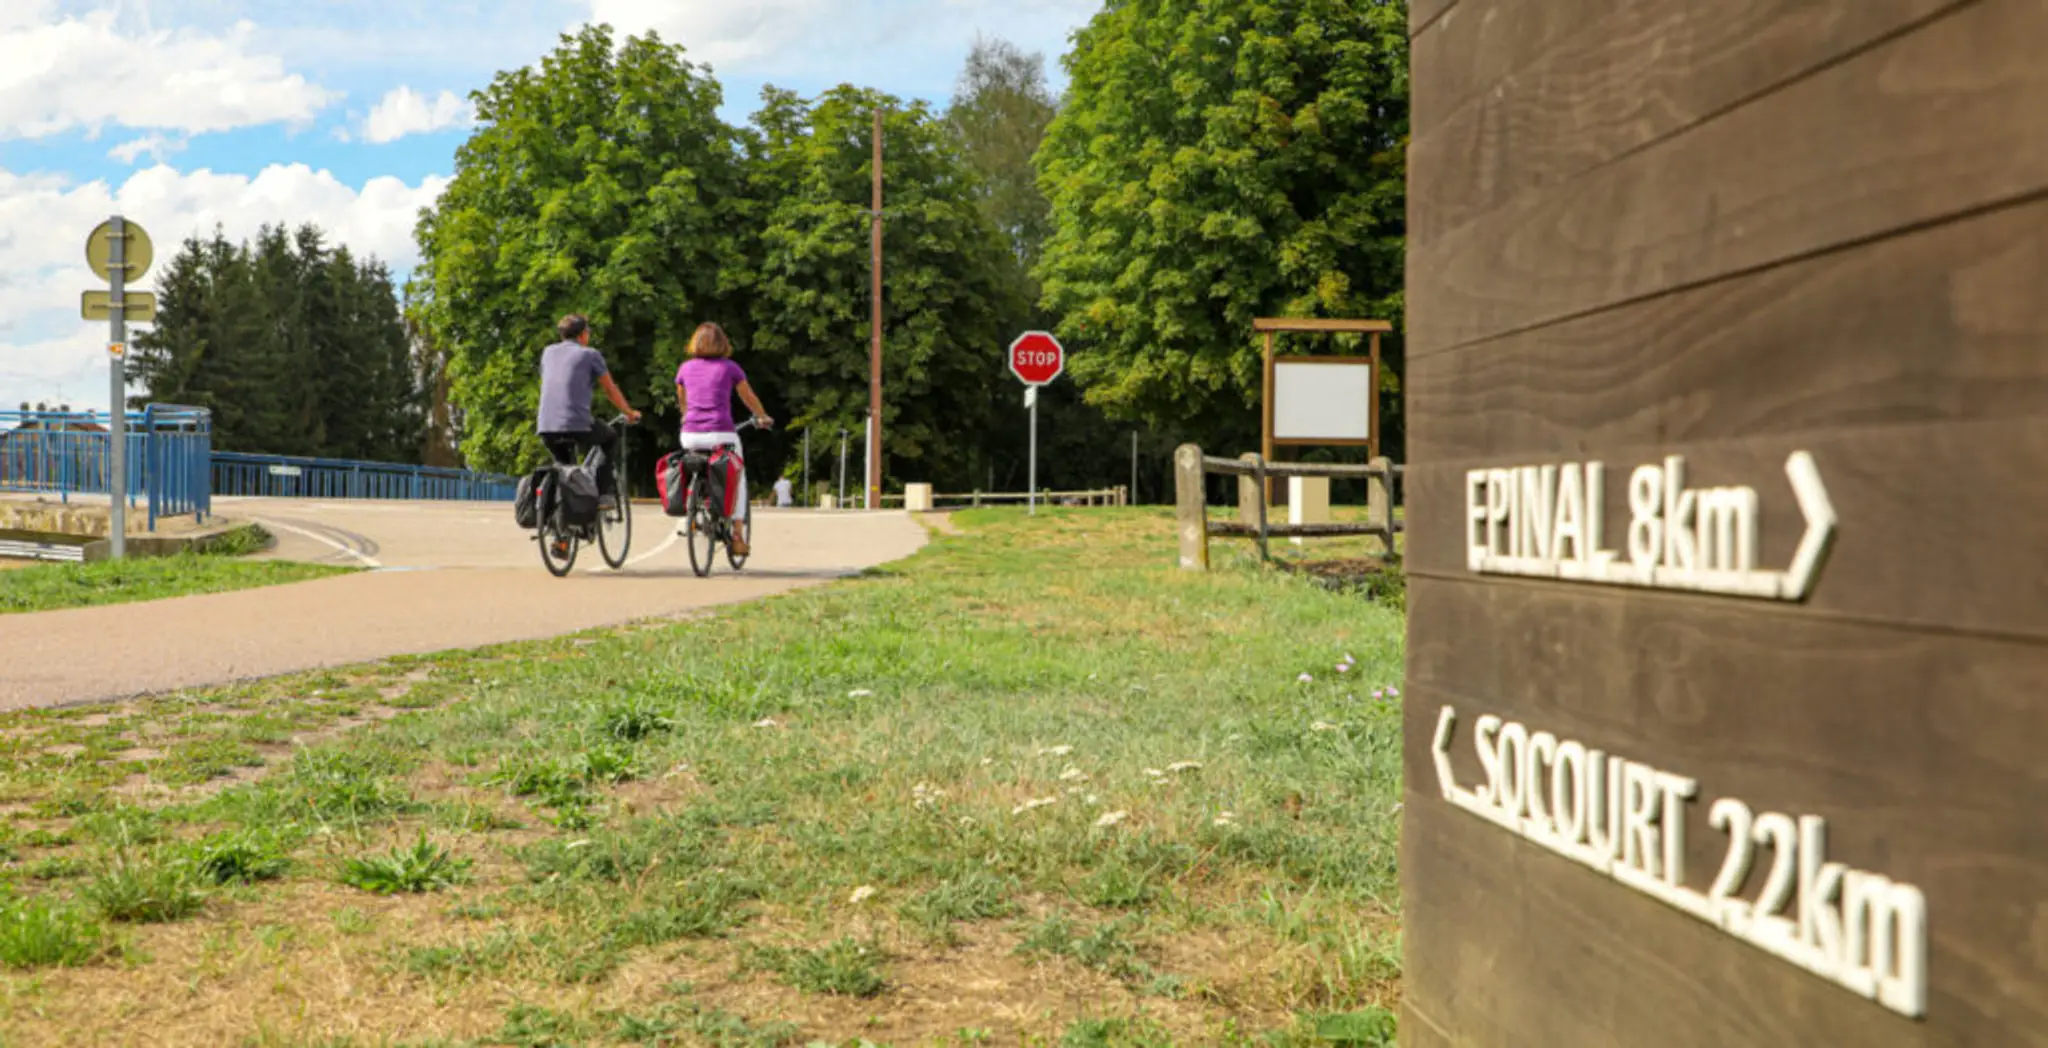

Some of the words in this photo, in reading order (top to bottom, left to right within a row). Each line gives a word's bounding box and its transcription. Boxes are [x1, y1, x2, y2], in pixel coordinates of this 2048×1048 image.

[1017, 350, 1057, 366] STOP
[1467, 461, 1618, 570] EPINAL
[1628, 455, 1757, 577] 8km
[1474, 714, 1697, 887] SOCOURT
[1708, 799, 1926, 1017] 22km
